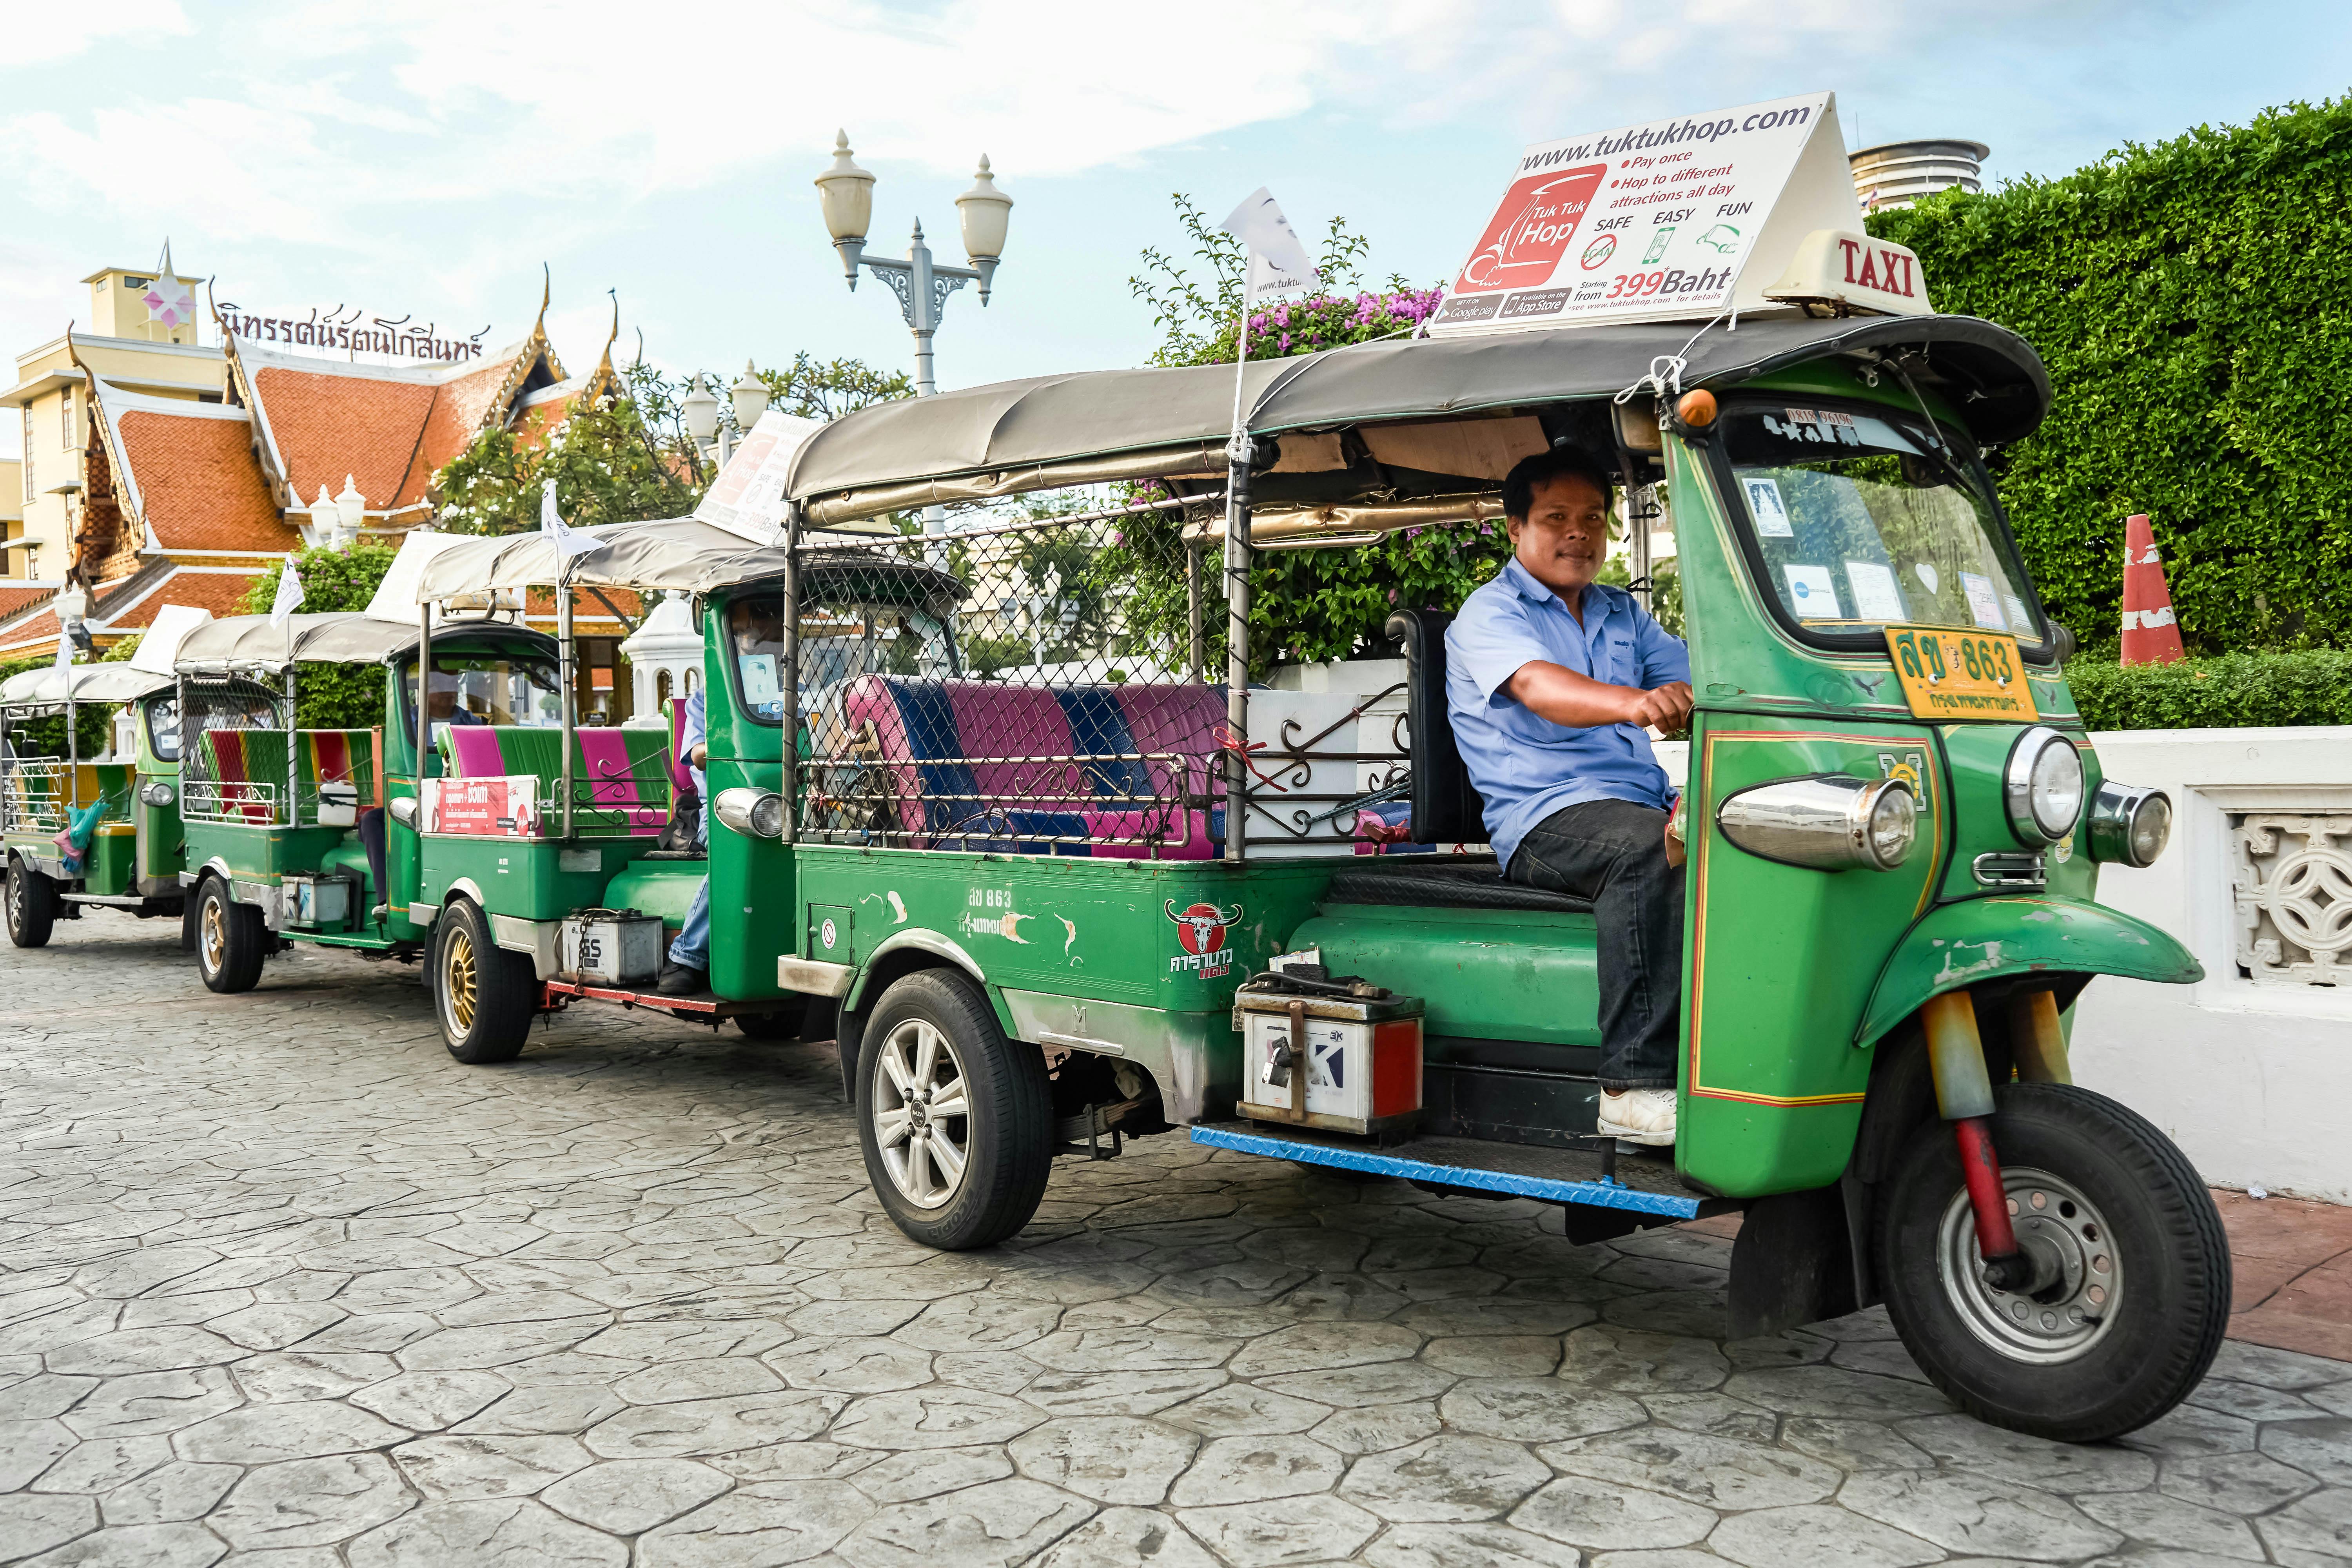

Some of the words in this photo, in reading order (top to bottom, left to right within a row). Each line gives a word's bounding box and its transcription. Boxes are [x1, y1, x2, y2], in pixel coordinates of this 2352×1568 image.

[1523, 105, 1811, 171] www.tuktukhop.com
[1631, 156, 1656, 169] Pay
[1659, 150, 1692, 163] once
[1621, 177, 1648, 190] Hop
[1653, 174, 1666, 185] to
[1671, 164, 1733, 182] different
[1610, 191, 1685, 209] attractions
[1688, 185, 1705, 199] all
[1708, 182, 1735, 201] day
[1533, 205, 1558, 219] Tuk
[1561, 200, 1587, 215] Tuk
[1594, 215, 1634, 232] SAFE
[1653, 208, 1696, 225] EASY
[1716, 201, 1753, 217] FUN
[1519, 220, 1573, 247] Hop
[1581, 247, 1615, 260] SCAM
[1839, 239, 1915, 297] TAXI
[1257, 278, 1303, 293] www.tuktu
[1580, 280, 1608, 289] Starting
[1574, 290, 1602, 301] from
[1588, 297, 1671, 310] www.tuktukhop.com
[1692, 292, 1720, 301] details
[1451, 307, 1479, 319] Google
[1478, 306, 1497, 318] play
[1516, 302, 1535, 314] App
[1535, 300, 1562, 311] Store
[759, 473, 771, 483] SAFE
[774, 478, 785, 487] EAS
[1961, 638, 2013, 682] 863
[987, 889, 1011, 908] 863
[1170, 948, 1233, 973] คาราบาว
[1199, 964, 1229, 980] แดง
[1072, 1005, 1087, 1033] M
[1330, 1030, 1343, 1042] 3K
